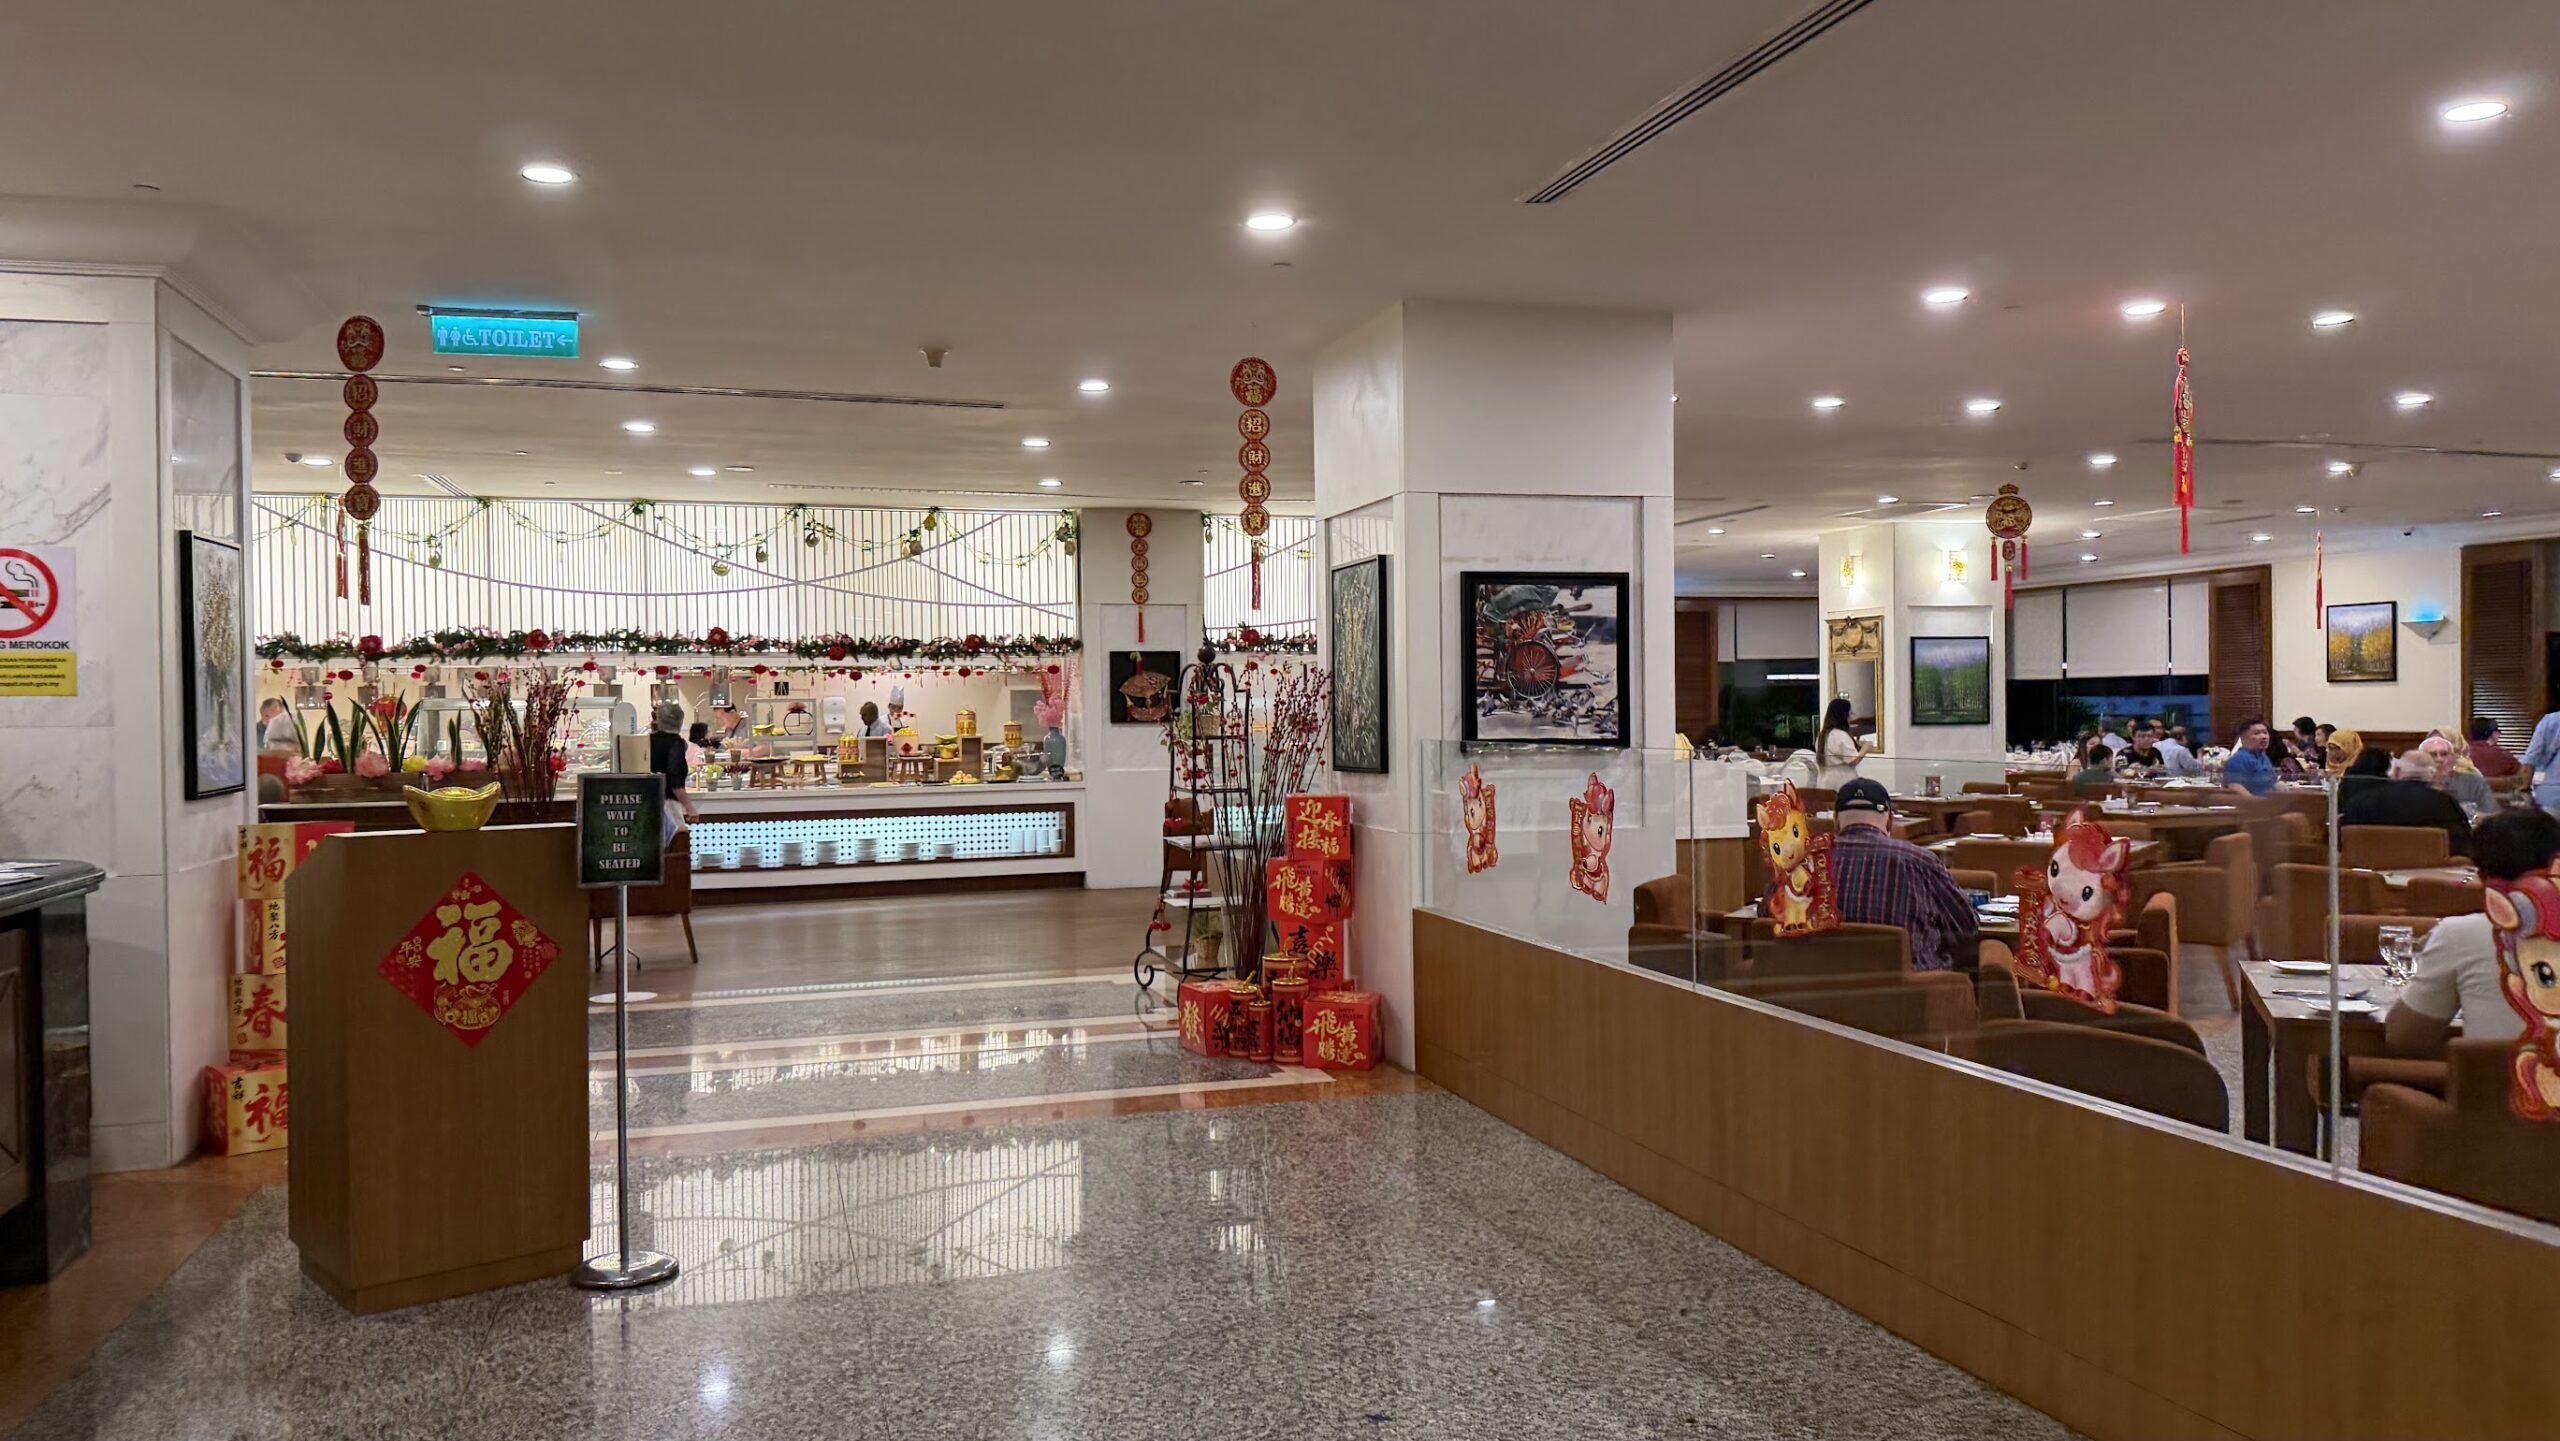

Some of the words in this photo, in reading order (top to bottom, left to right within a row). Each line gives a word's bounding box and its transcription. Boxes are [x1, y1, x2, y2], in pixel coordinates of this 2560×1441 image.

[479, 328, 556, 348] TOILET
[9, 640, 70, 650] MEROKOK
[600, 795, 643, 804] PLEASE
[606, 811, 637, 820] WAIT
[614, 827, 629, 836] TO
[613, 843, 628, 852] BE
[248, 836, 286, 882] 福
[599, 858, 641, 869] SEATED
[426, 900, 514, 985] 福
[238, 984, 287, 1039] 春
[244, 1083, 288, 1135] 福
